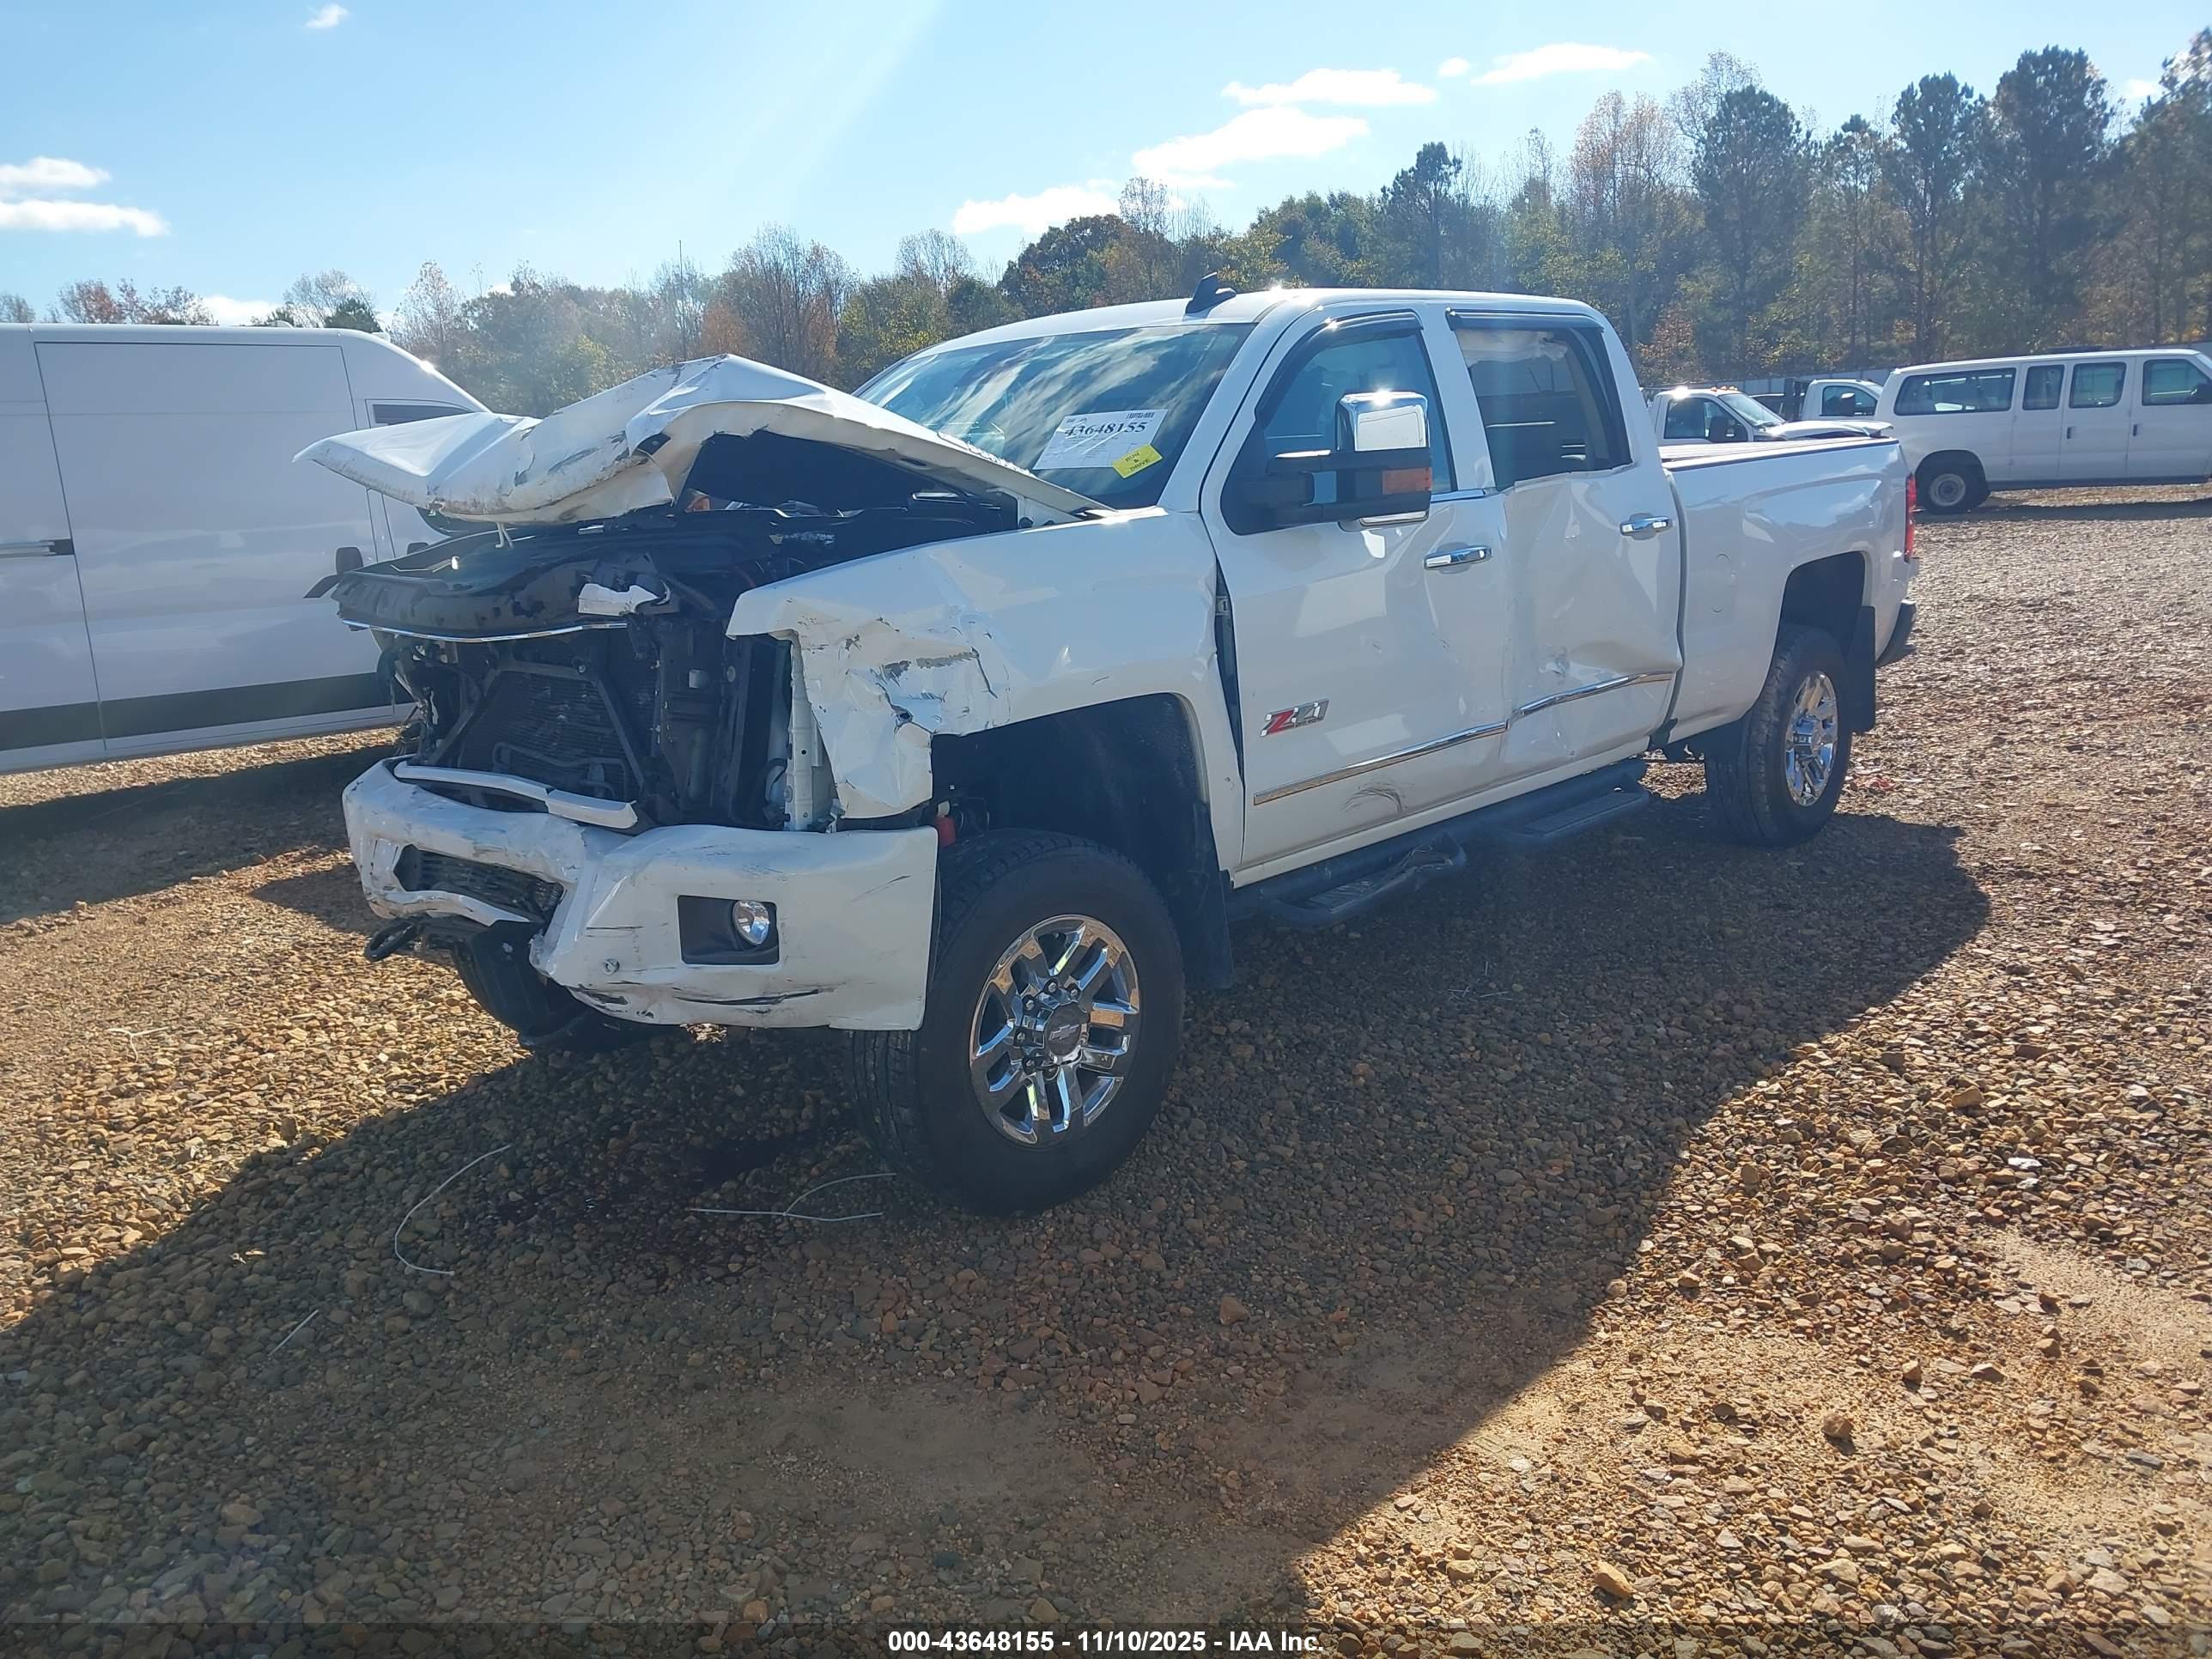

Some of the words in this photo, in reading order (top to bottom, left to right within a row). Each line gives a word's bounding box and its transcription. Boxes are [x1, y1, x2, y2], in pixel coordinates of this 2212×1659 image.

[1064, 422, 1148, 437] 43648155
[1125, 451, 1140, 462] RUN
[1129, 459, 1151, 471] DRIVE
